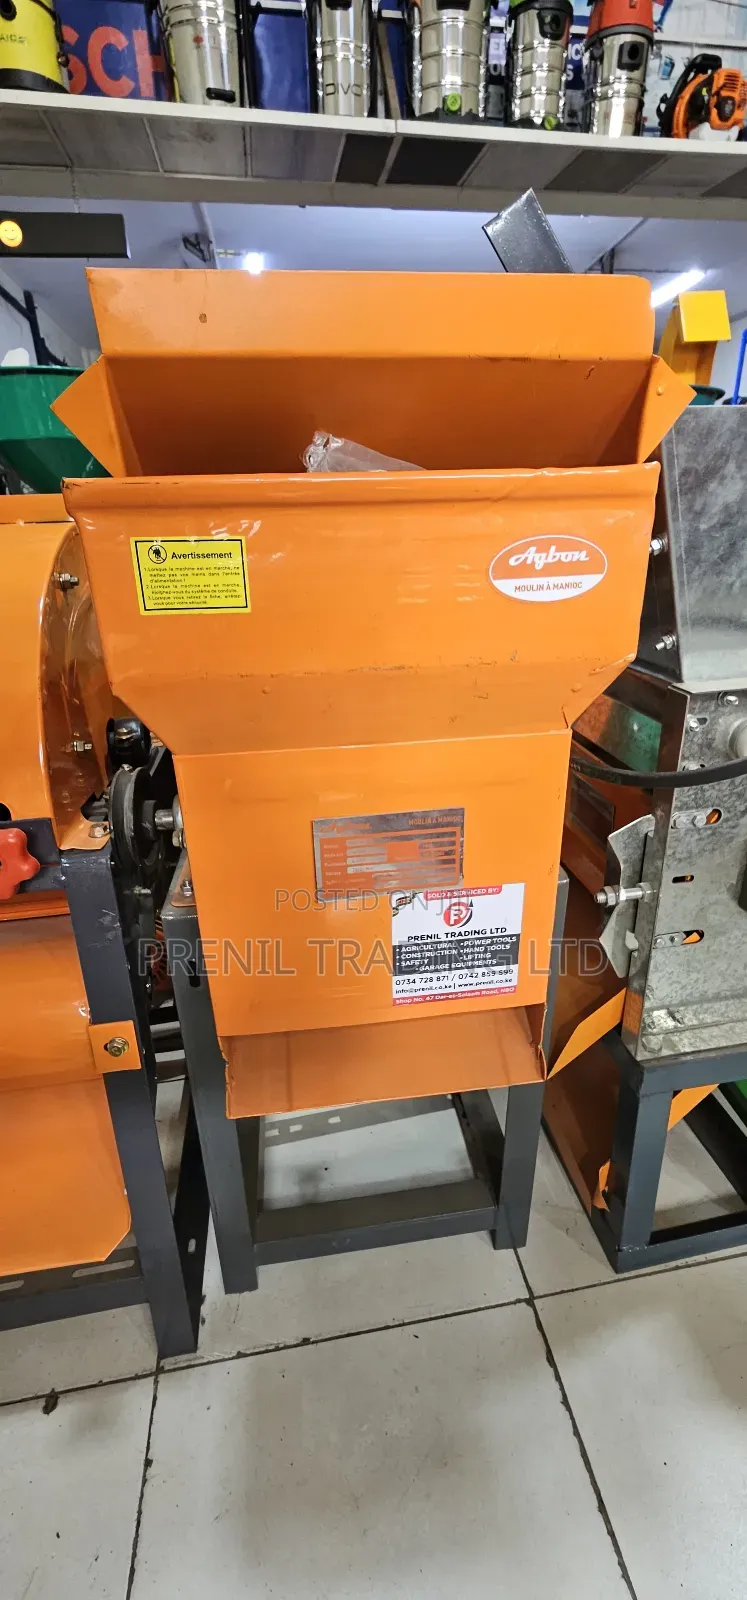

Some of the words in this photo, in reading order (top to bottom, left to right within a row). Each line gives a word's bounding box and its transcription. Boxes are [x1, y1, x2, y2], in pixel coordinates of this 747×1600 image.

[171, 552, 232, 560] Avertissement
[509, 545, 590, 570] Agbon
[514, 584, 544, 592] MOULIN
[553, 582, 583, 590] MANIOC
[408, 933, 442, 942] PRENIL
[444, 929, 487, 938] TRADING
[401, 943, 457, 952] AGRICULTURAL
[464, 939, 492, 947] POWER
[401, 949, 458, 959] CONSTRUCTION
[463, 946, 485, 954] HAND
[401, 959, 429, 967] SAFETY
[420, 963, 450, 971] GARAGE
[451, 959, 497, 968] EQUIPMENTS
